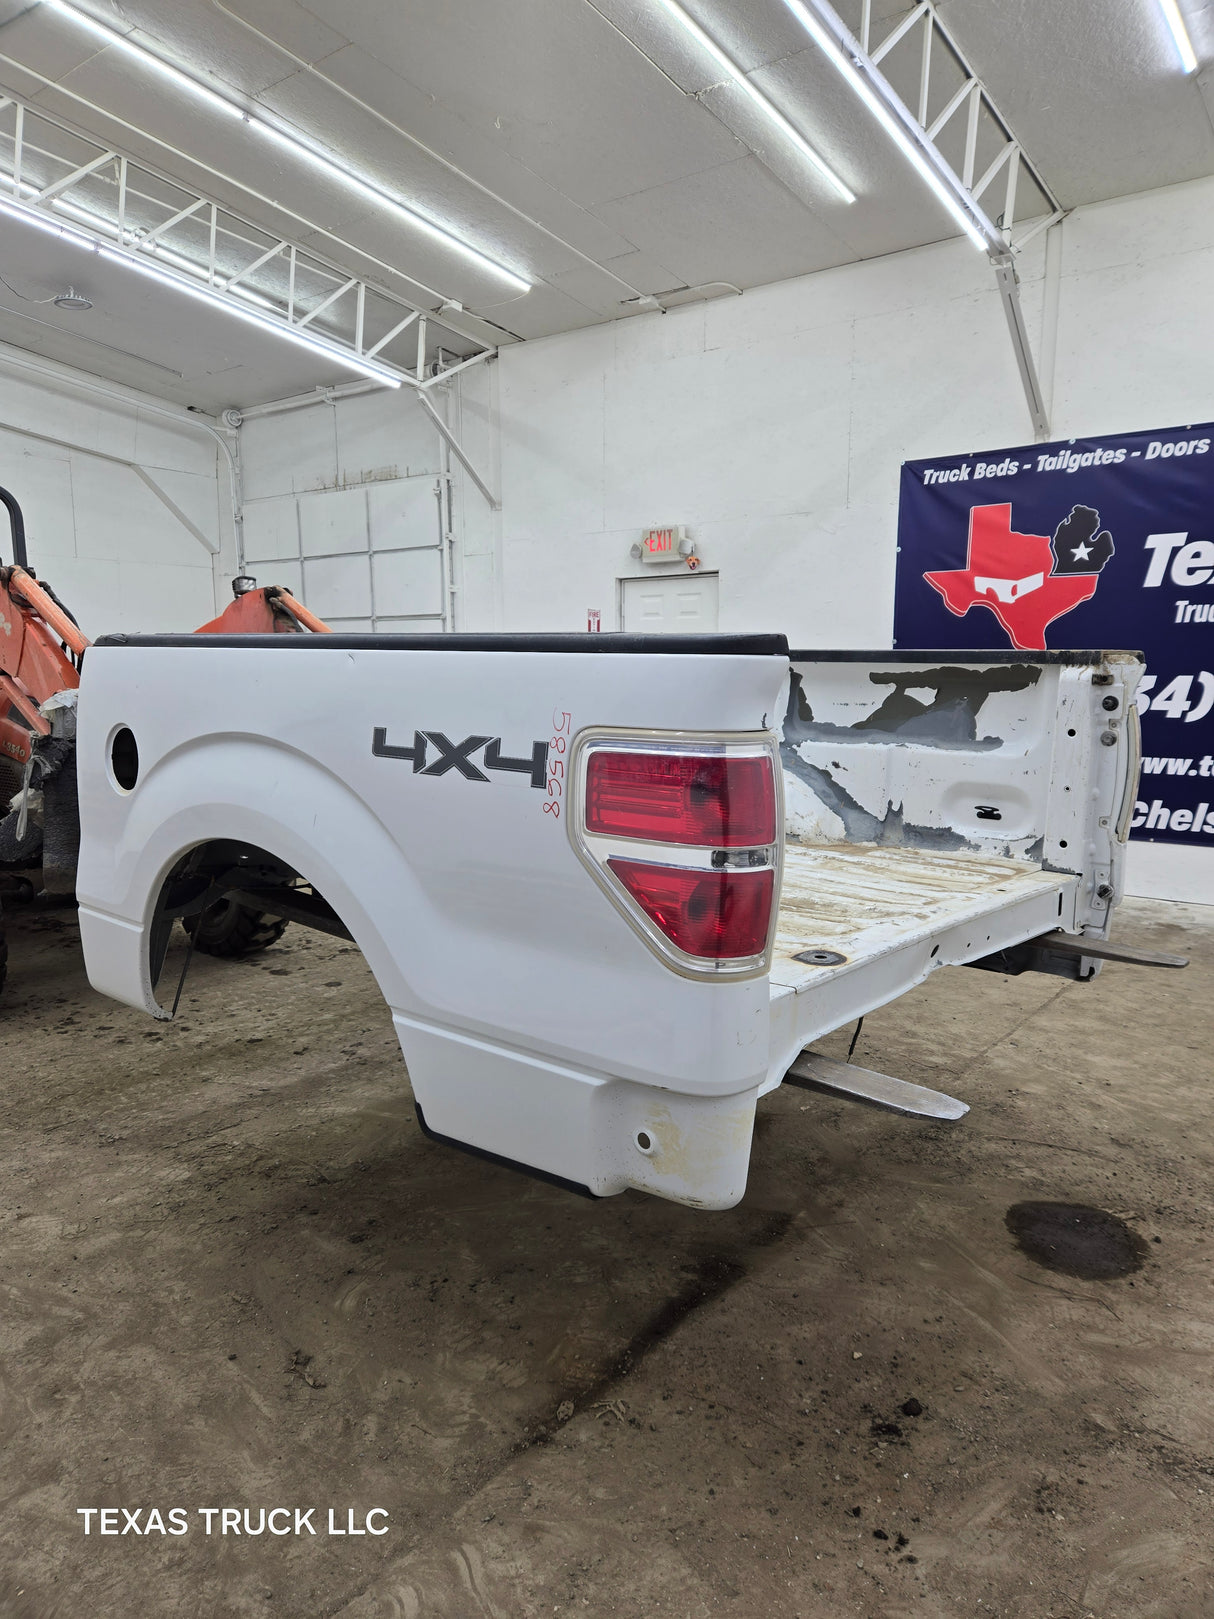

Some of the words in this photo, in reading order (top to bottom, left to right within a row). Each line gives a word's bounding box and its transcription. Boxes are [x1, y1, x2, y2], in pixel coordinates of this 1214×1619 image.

[923, 464, 969, 485] Truck
[973, 458, 1019, 480] Beds
[1036, 447, 1127, 473] Tailgates
[1144, 438, 1211, 460] Doors
[650, 529, 673, 552] EXIT
[1143, 531, 1214, 588] Te
[1139, 755, 1214, 777] ww.t
